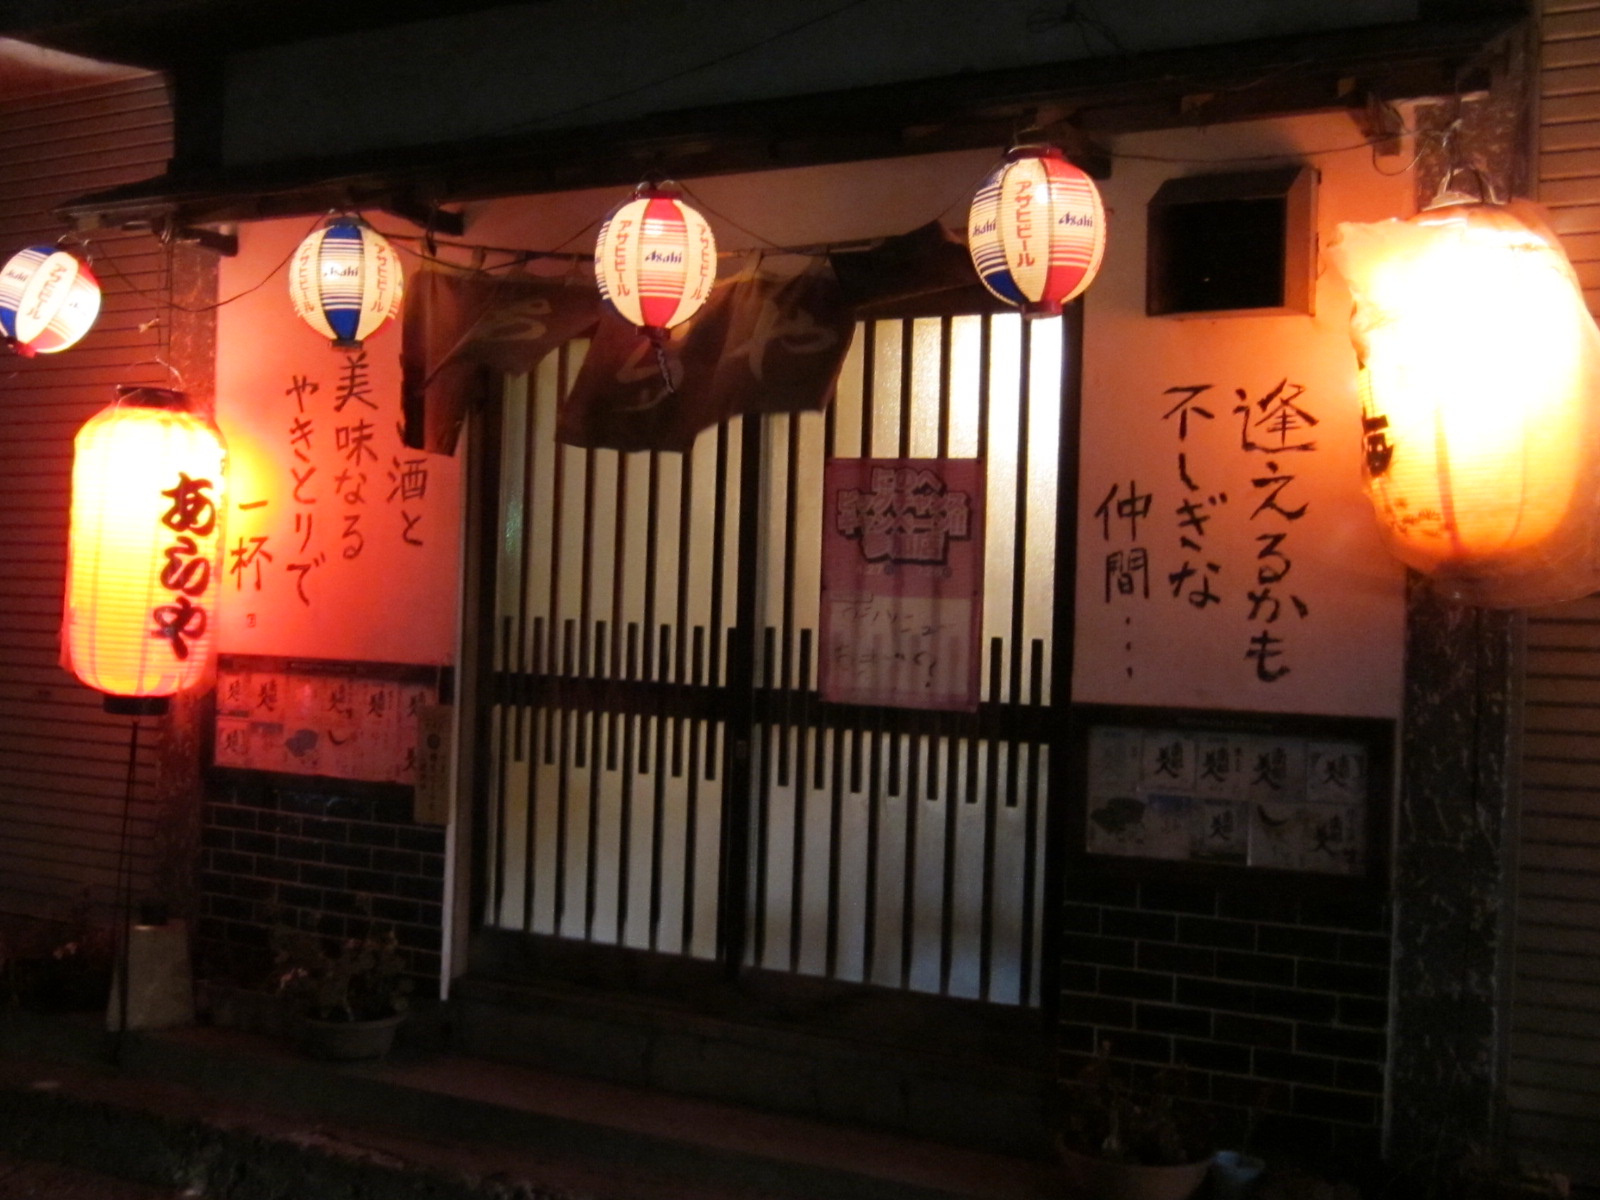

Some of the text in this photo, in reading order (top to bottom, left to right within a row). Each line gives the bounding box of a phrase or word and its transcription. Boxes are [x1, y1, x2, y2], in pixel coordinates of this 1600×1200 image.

[614, 220, 632, 297] アサヒビール
[645, 250, 682, 264] Asahi
[1014, 181, 1035, 267] アサヒビール
[1058, 212, 1093, 228] Asahi
[371, 243, 388, 313] アサヒビール
[286, 374, 326, 607] やきとりで
[334, 352, 379, 560] 美味なる
[1162, 383, 1228, 609] 不しぎな
[229, 500, 272, 591] 一杯
[1233, 377, 1319, 684] 逢えるかも
